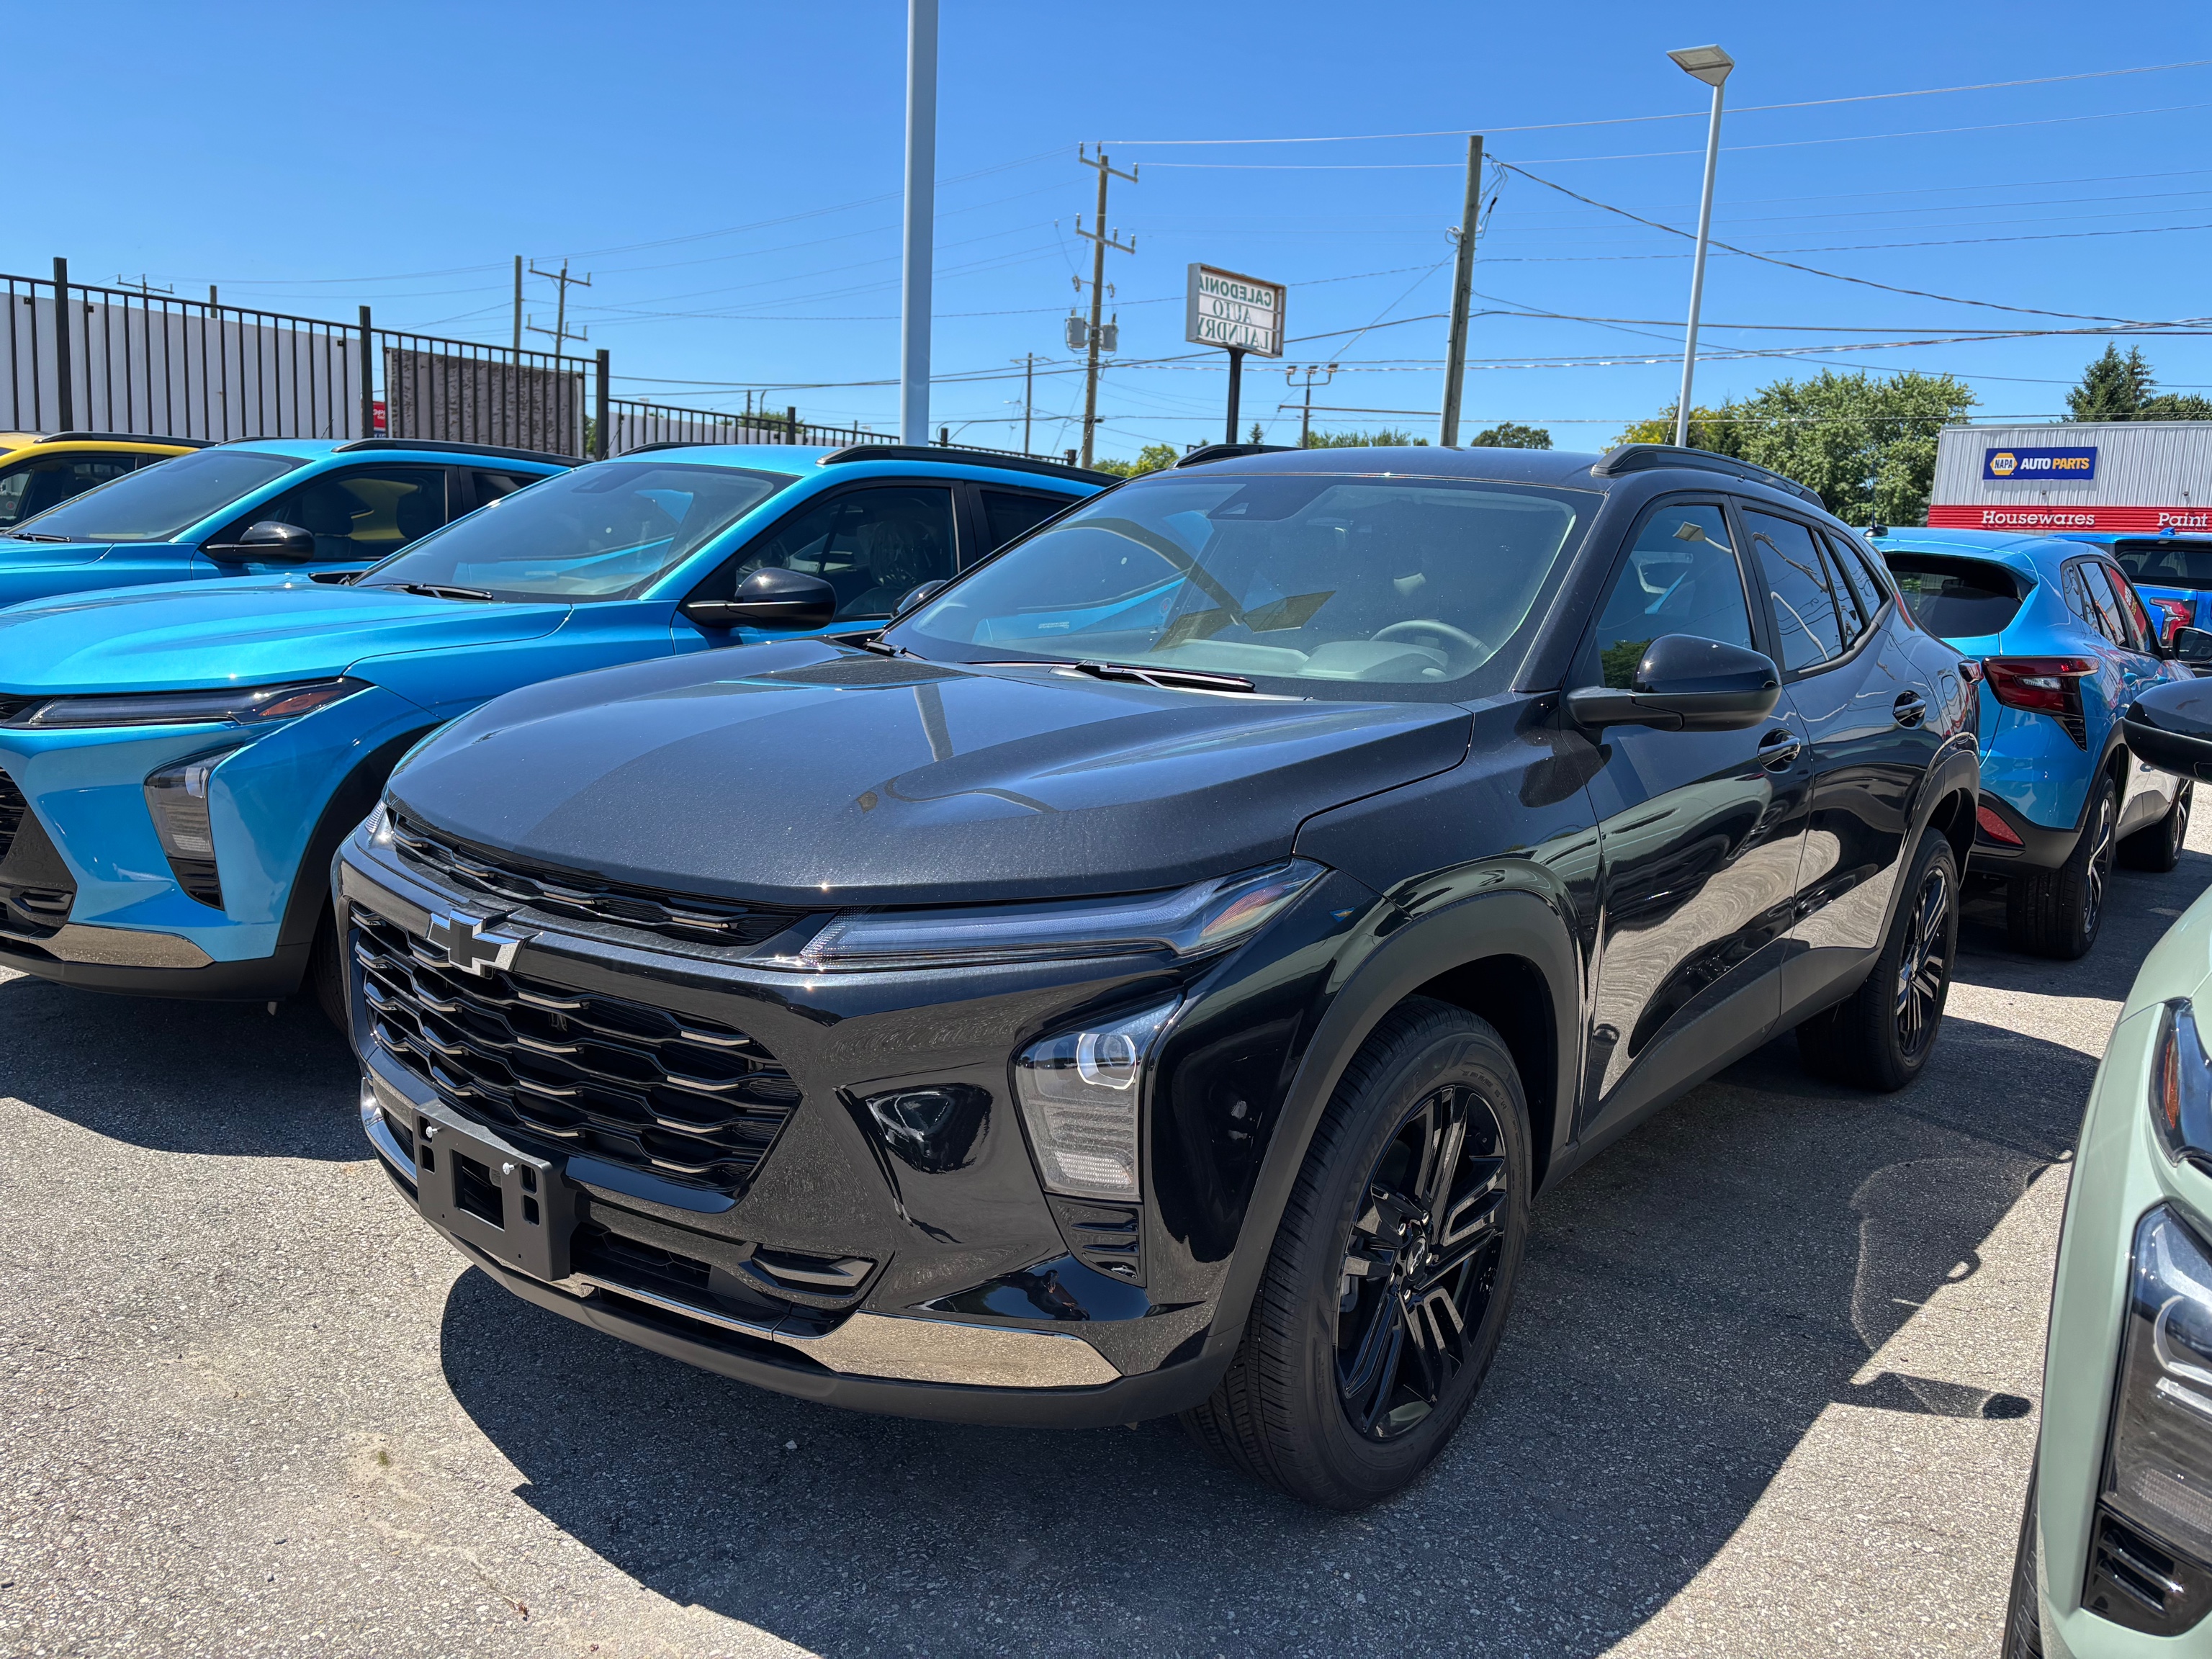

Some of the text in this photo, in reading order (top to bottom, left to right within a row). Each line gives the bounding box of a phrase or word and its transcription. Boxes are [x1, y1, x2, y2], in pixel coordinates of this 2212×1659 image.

[1994, 457, 2090, 470] NAPA AUTO PARTS
[1981, 510, 2095, 526] Housewares
[2157, 512, 2208, 527] Paint
